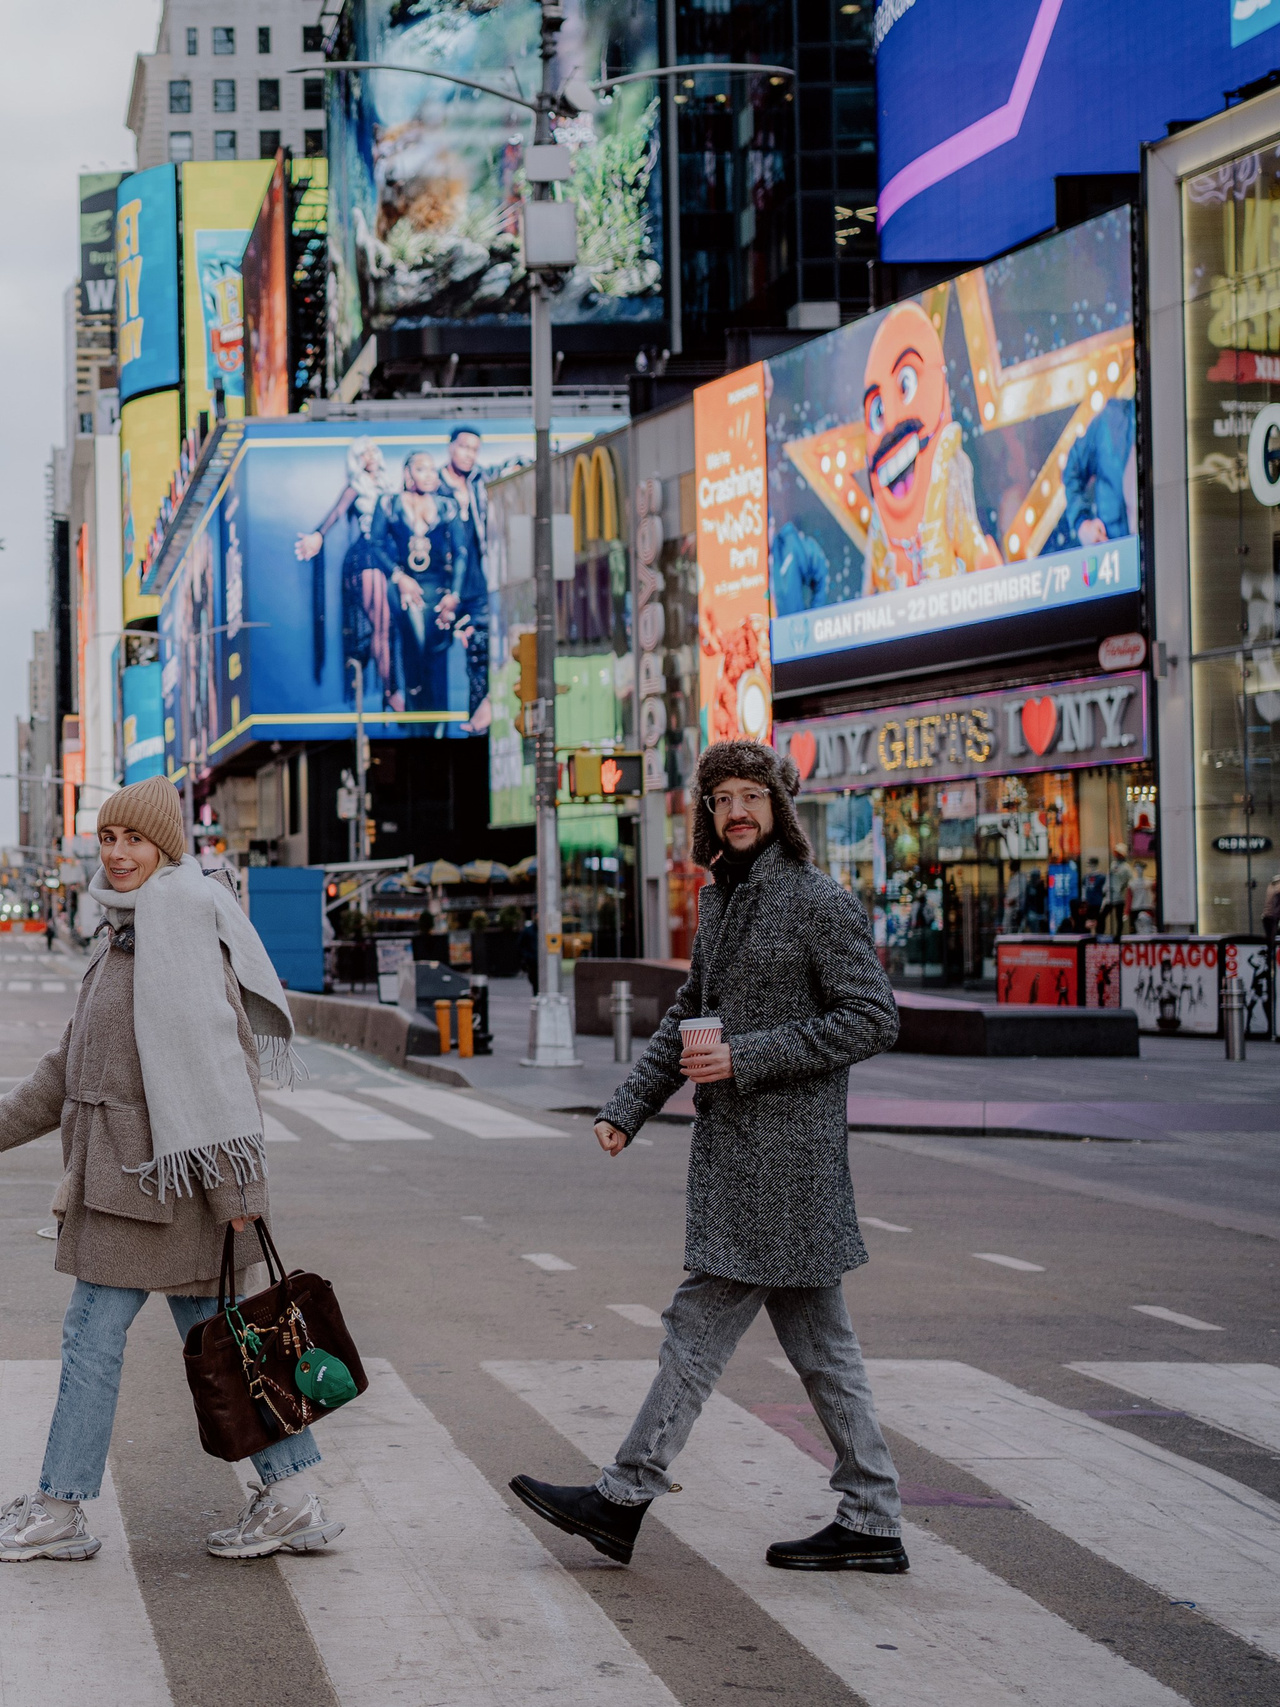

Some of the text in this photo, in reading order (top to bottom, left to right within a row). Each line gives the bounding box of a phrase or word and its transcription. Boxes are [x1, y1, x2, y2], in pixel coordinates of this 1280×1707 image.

[698, 464, 764, 510] Crashing
[729, 546, 759, 570] Party
[814, 613, 852, 643] GRAN
[853, 606, 895, 638] FINAL
[907, 598, 927, 623] 22
[928, 594, 949, 618] DE
[950, 571, 1042, 614] DICIEMBRE
[1098, 549, 1120, 586] 41
[878, 708, 997, 772] GIFTS
[1122, 943, 1218, 968] CHICAGO
